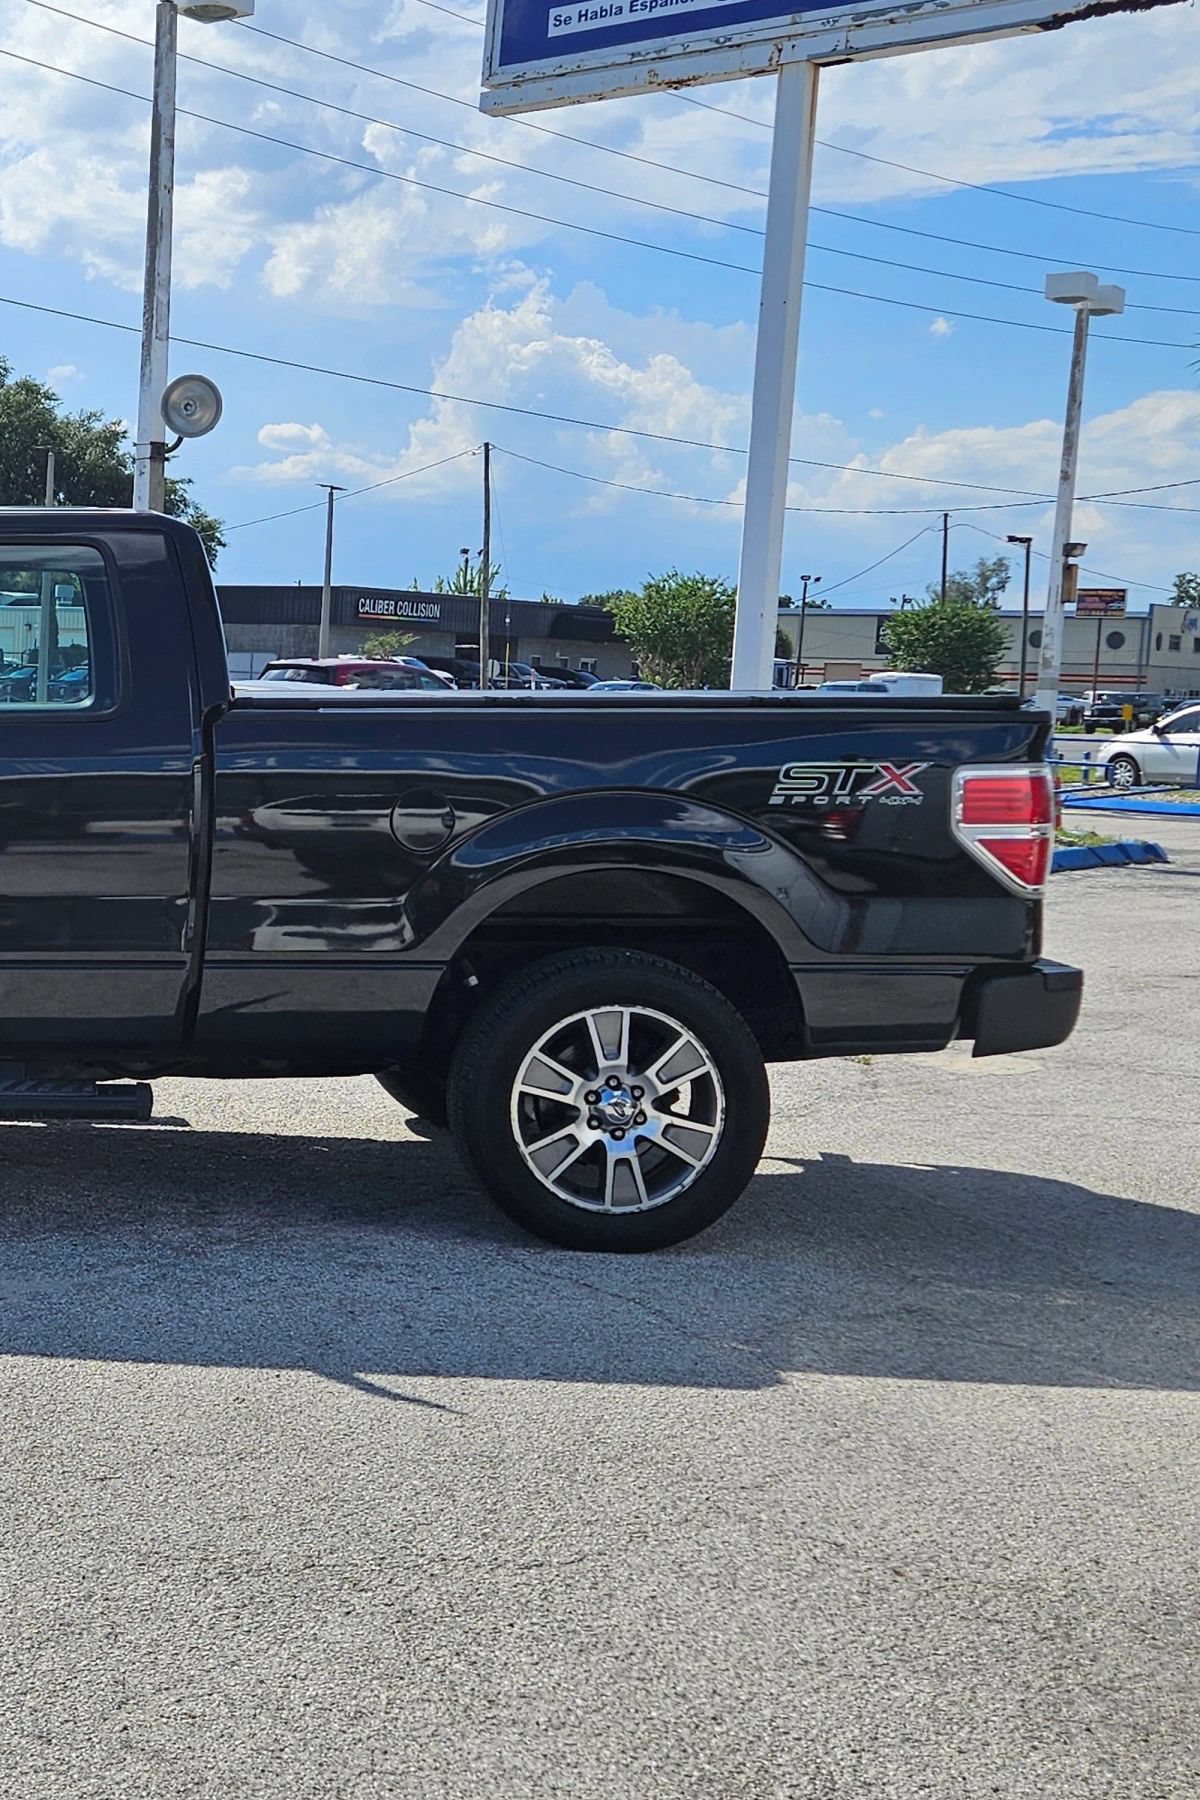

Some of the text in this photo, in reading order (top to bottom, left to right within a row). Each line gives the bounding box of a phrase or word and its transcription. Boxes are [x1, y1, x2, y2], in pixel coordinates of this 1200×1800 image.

[552, 0, 697, 27] Se Habla Espa
[358, 598, 440, 618] CALIBER COLLISION
[772, 762, 935, 795] STX
[768, 796, 872, 805] SPORT
